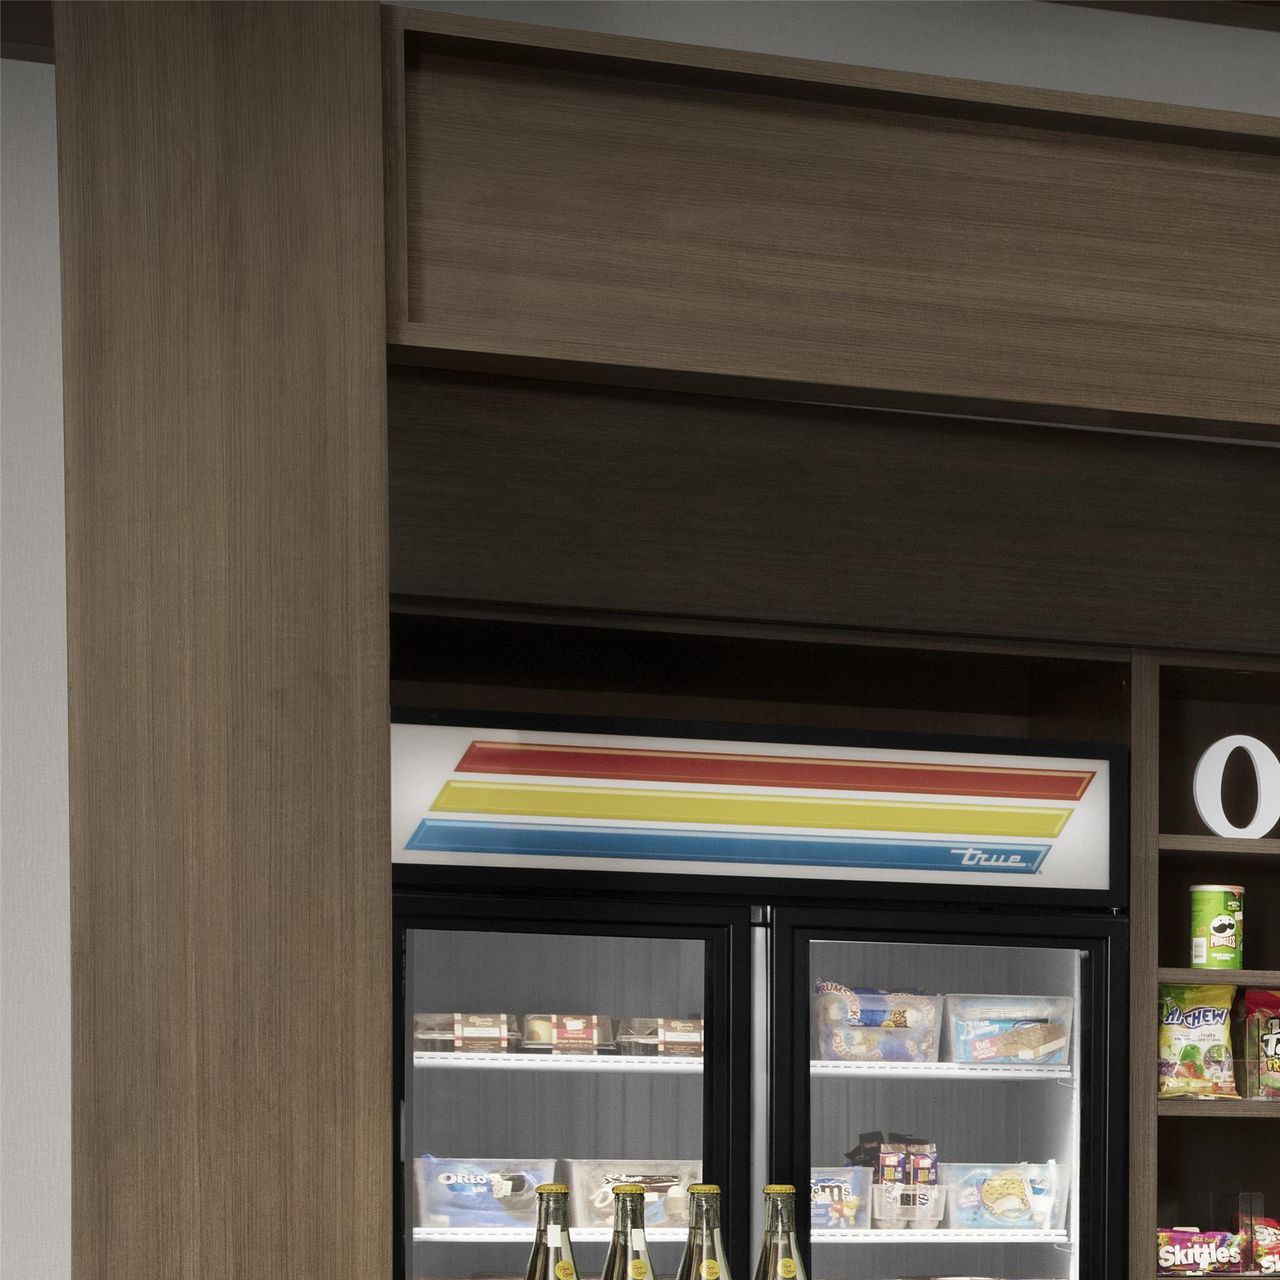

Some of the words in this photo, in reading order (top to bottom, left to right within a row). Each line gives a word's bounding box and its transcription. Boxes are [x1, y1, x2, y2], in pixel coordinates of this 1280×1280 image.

[951, 846, 1027, 867] true
[438, 1173, 486, 1185] OREO
[1158, 1241, 1241, 1269] Skittles
